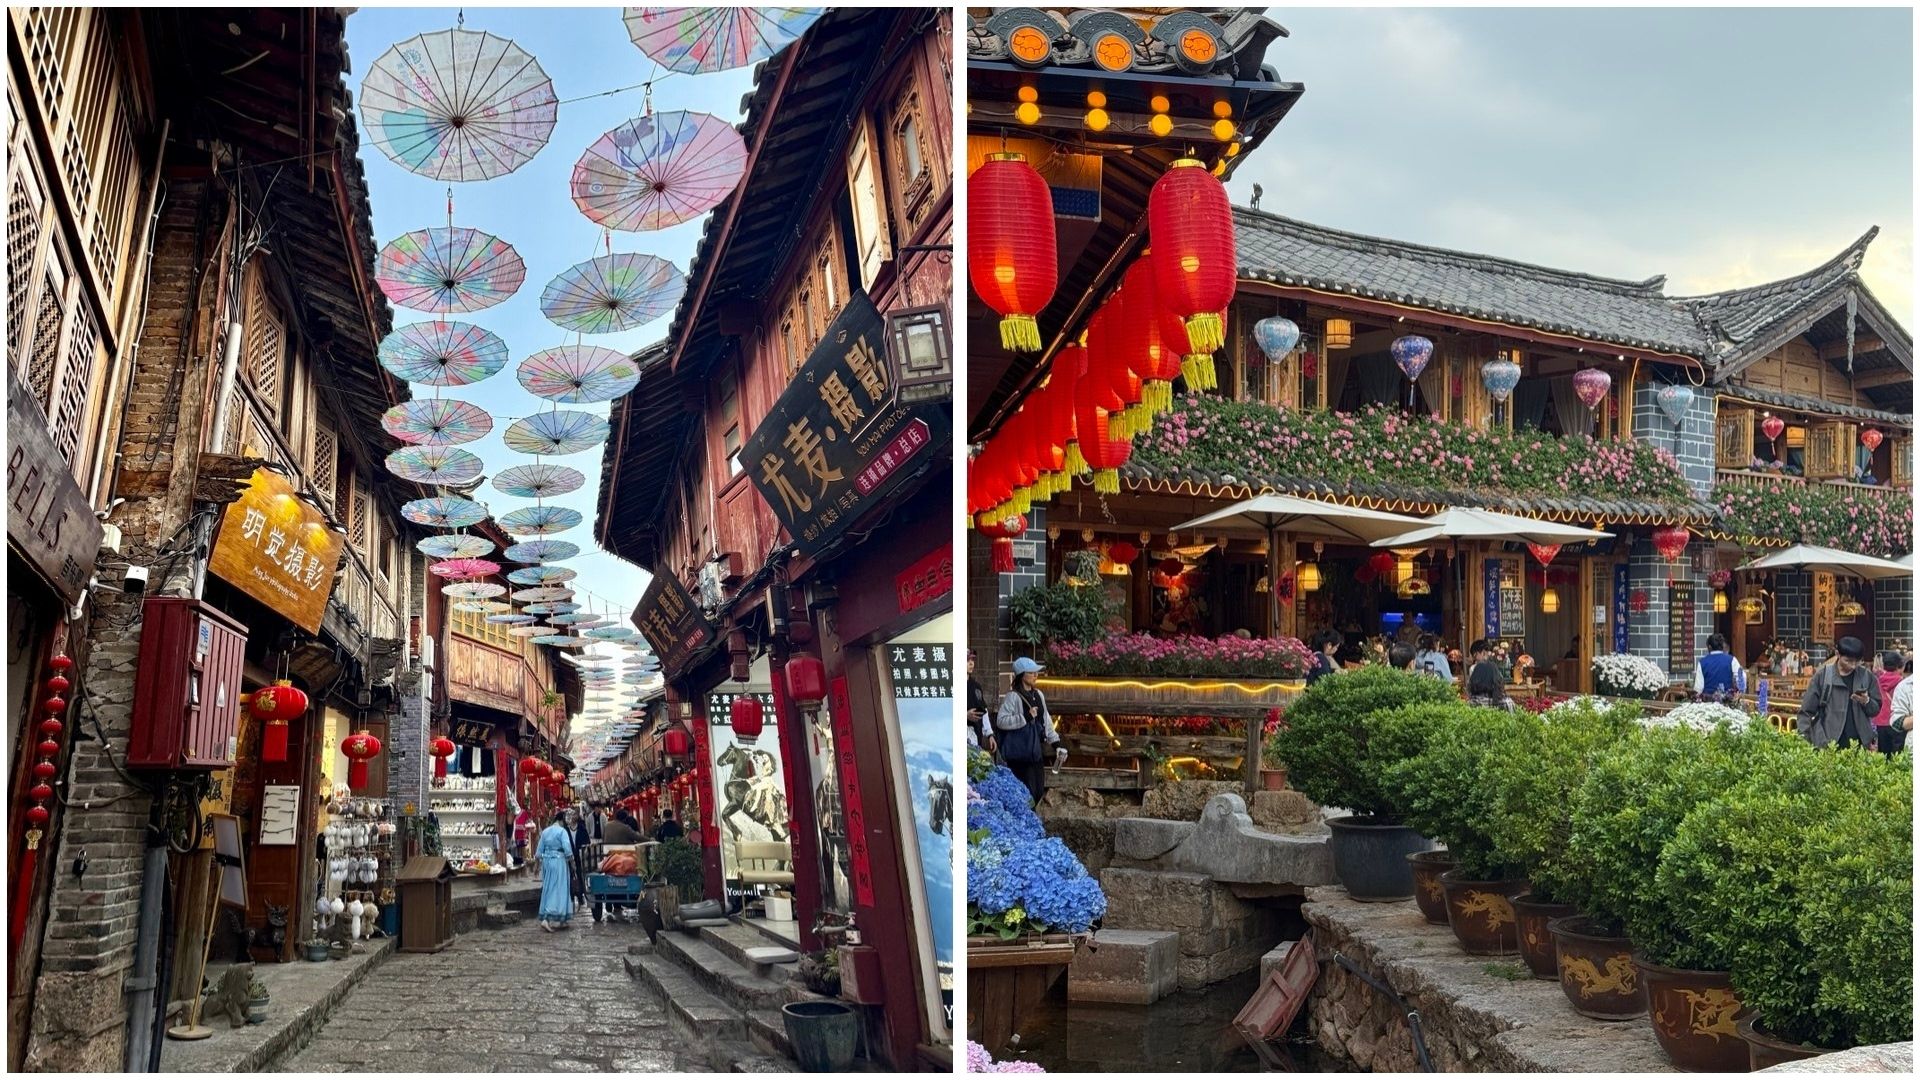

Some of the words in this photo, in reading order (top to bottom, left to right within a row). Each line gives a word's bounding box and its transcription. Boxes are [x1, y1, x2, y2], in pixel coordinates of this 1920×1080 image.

[7, 445, 68, 551] BELLS
[242, 506, 325, 591] 明觉摄影
